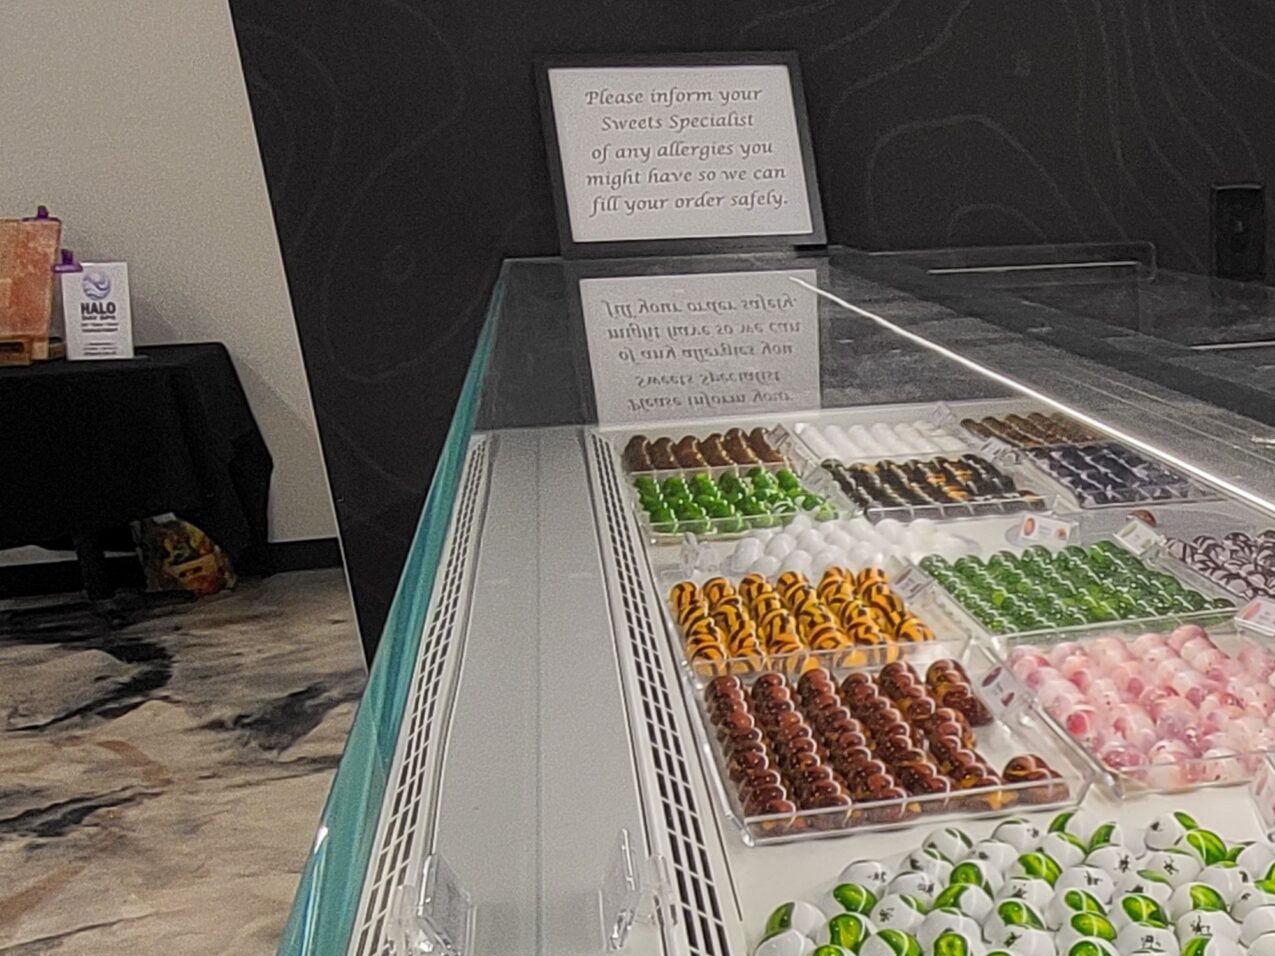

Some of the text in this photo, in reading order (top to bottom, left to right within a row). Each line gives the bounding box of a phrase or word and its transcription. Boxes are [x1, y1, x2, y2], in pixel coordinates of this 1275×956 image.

[585, 87, 763, 108] Please inform your
[601, 111, 754, 132] Sweets Specialist
[591, 140, 773, 164] of any allergies you
[586, 167, 786, 190] might have so we can
[589, 189, 788, 218] fill your order safely.
[81, 302, 116, 314] HALO
